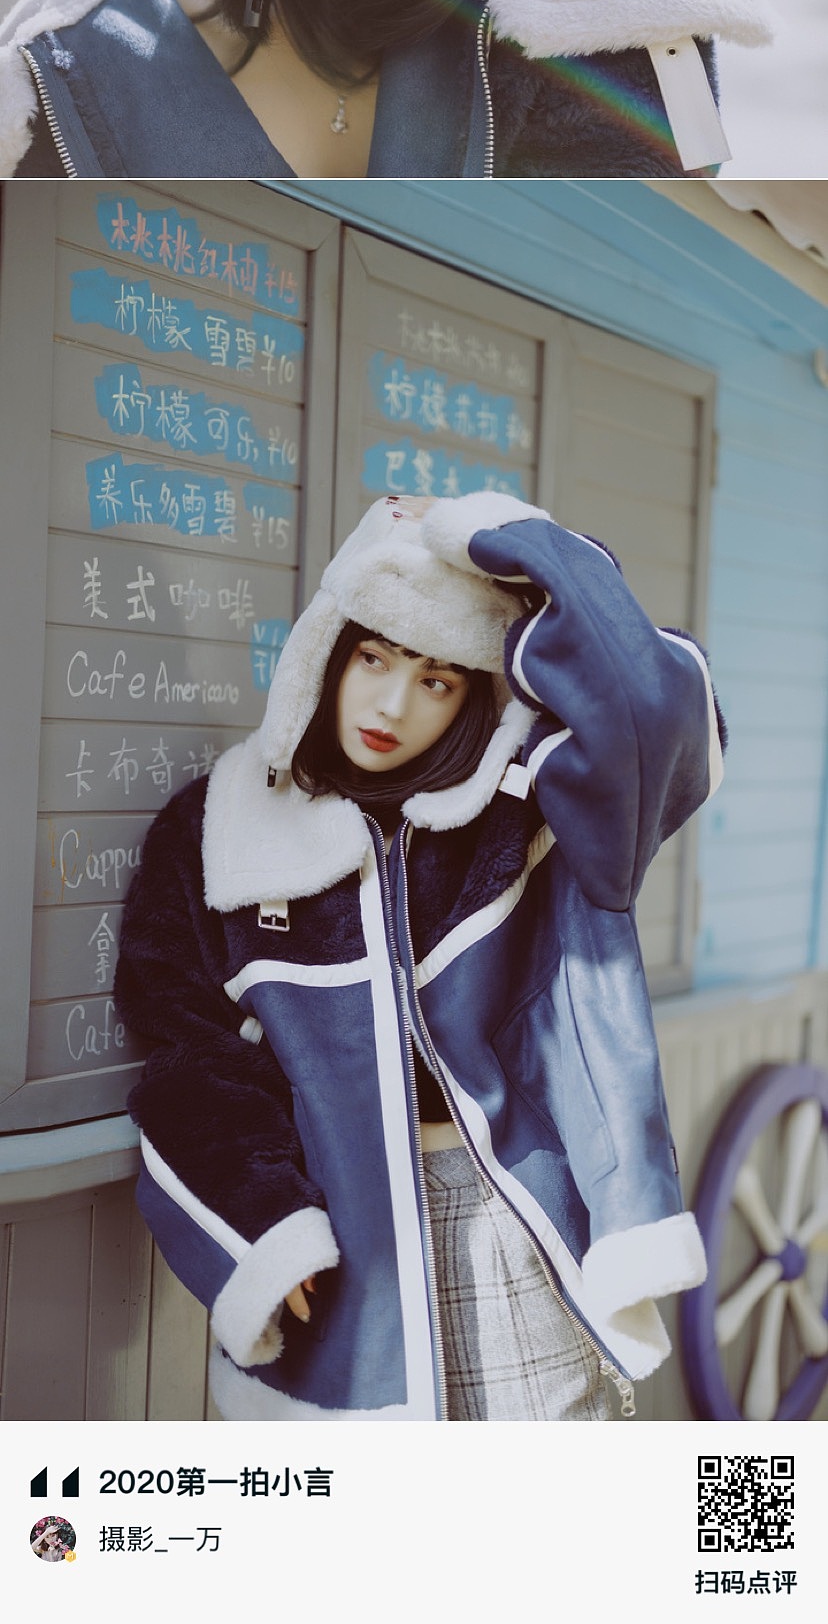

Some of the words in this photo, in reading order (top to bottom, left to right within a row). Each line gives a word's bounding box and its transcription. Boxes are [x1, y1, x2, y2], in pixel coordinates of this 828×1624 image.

[111, 201, 258, 297] 桃桃红柚
[264, 261, 299, 304] ¥15
[114, 282, 256, 376] 柠檬雪碧
[260, 334, 296, 386] ¥10
[112, 374, 259, 462] 柠檬可乐
[96, 463, 238, 544] 养乐多雪碧
[251, 504, 291, 549] ¥15
[83, 556, 256, 630] 美式咖啡
[67, 649, 146, 699] Cafe
[88, 912, 115, 984] 拿
